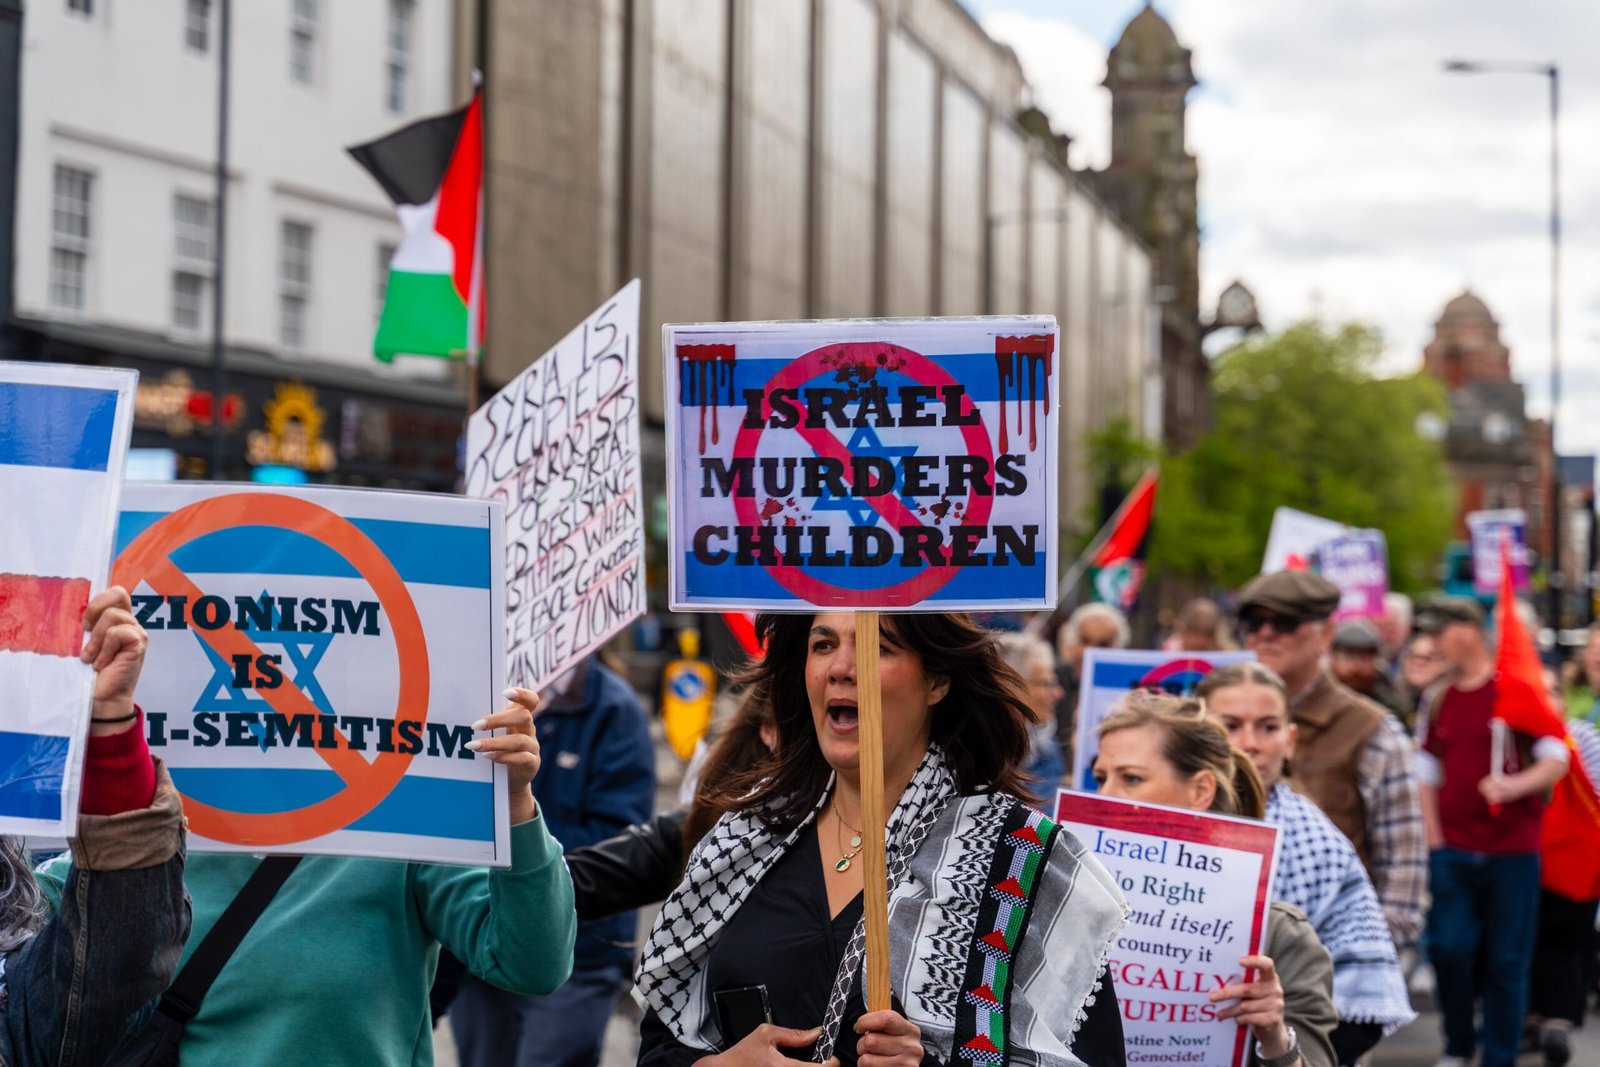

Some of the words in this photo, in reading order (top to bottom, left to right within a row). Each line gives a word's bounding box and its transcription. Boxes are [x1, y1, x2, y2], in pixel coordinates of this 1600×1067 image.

[482, 350, 560, 455] SYRIA
[583, 302, 617, 373] IS
[468, 334, 630, 497] OCCUPIED!
[743, 384, 980, 429] ISRAEL
[520, 483, 549, 532] OF
[560, 418, 630, 503] SYRIA!
[700, 454, 1027, 498] MURDERS
[583, 490, 636, 556] WHEN
[693, 525, 1039, 567] CHILDREN
[131, 594, 380, 636] ZIONISM
[531, 579, 572, 638] FACE
[232, 654, 283, 689] IS
[147, 712, 475, 760] I-SEMITISM
[1095, 830, 1168, 864] Israel
[1175, 844, 1223, 873] has
[1141, 875, 1206, 906] Right
[1117, 936, 1193, 964] country
[1198, 946, 1213, 962] it
[1170, 912, 1235, 945] itself,
[1124, 1034, 1164, 1046] stine
[1168, 1035, 1211, 1046] Now!
[1126, 1050, 1206, 1062] Genocide!
